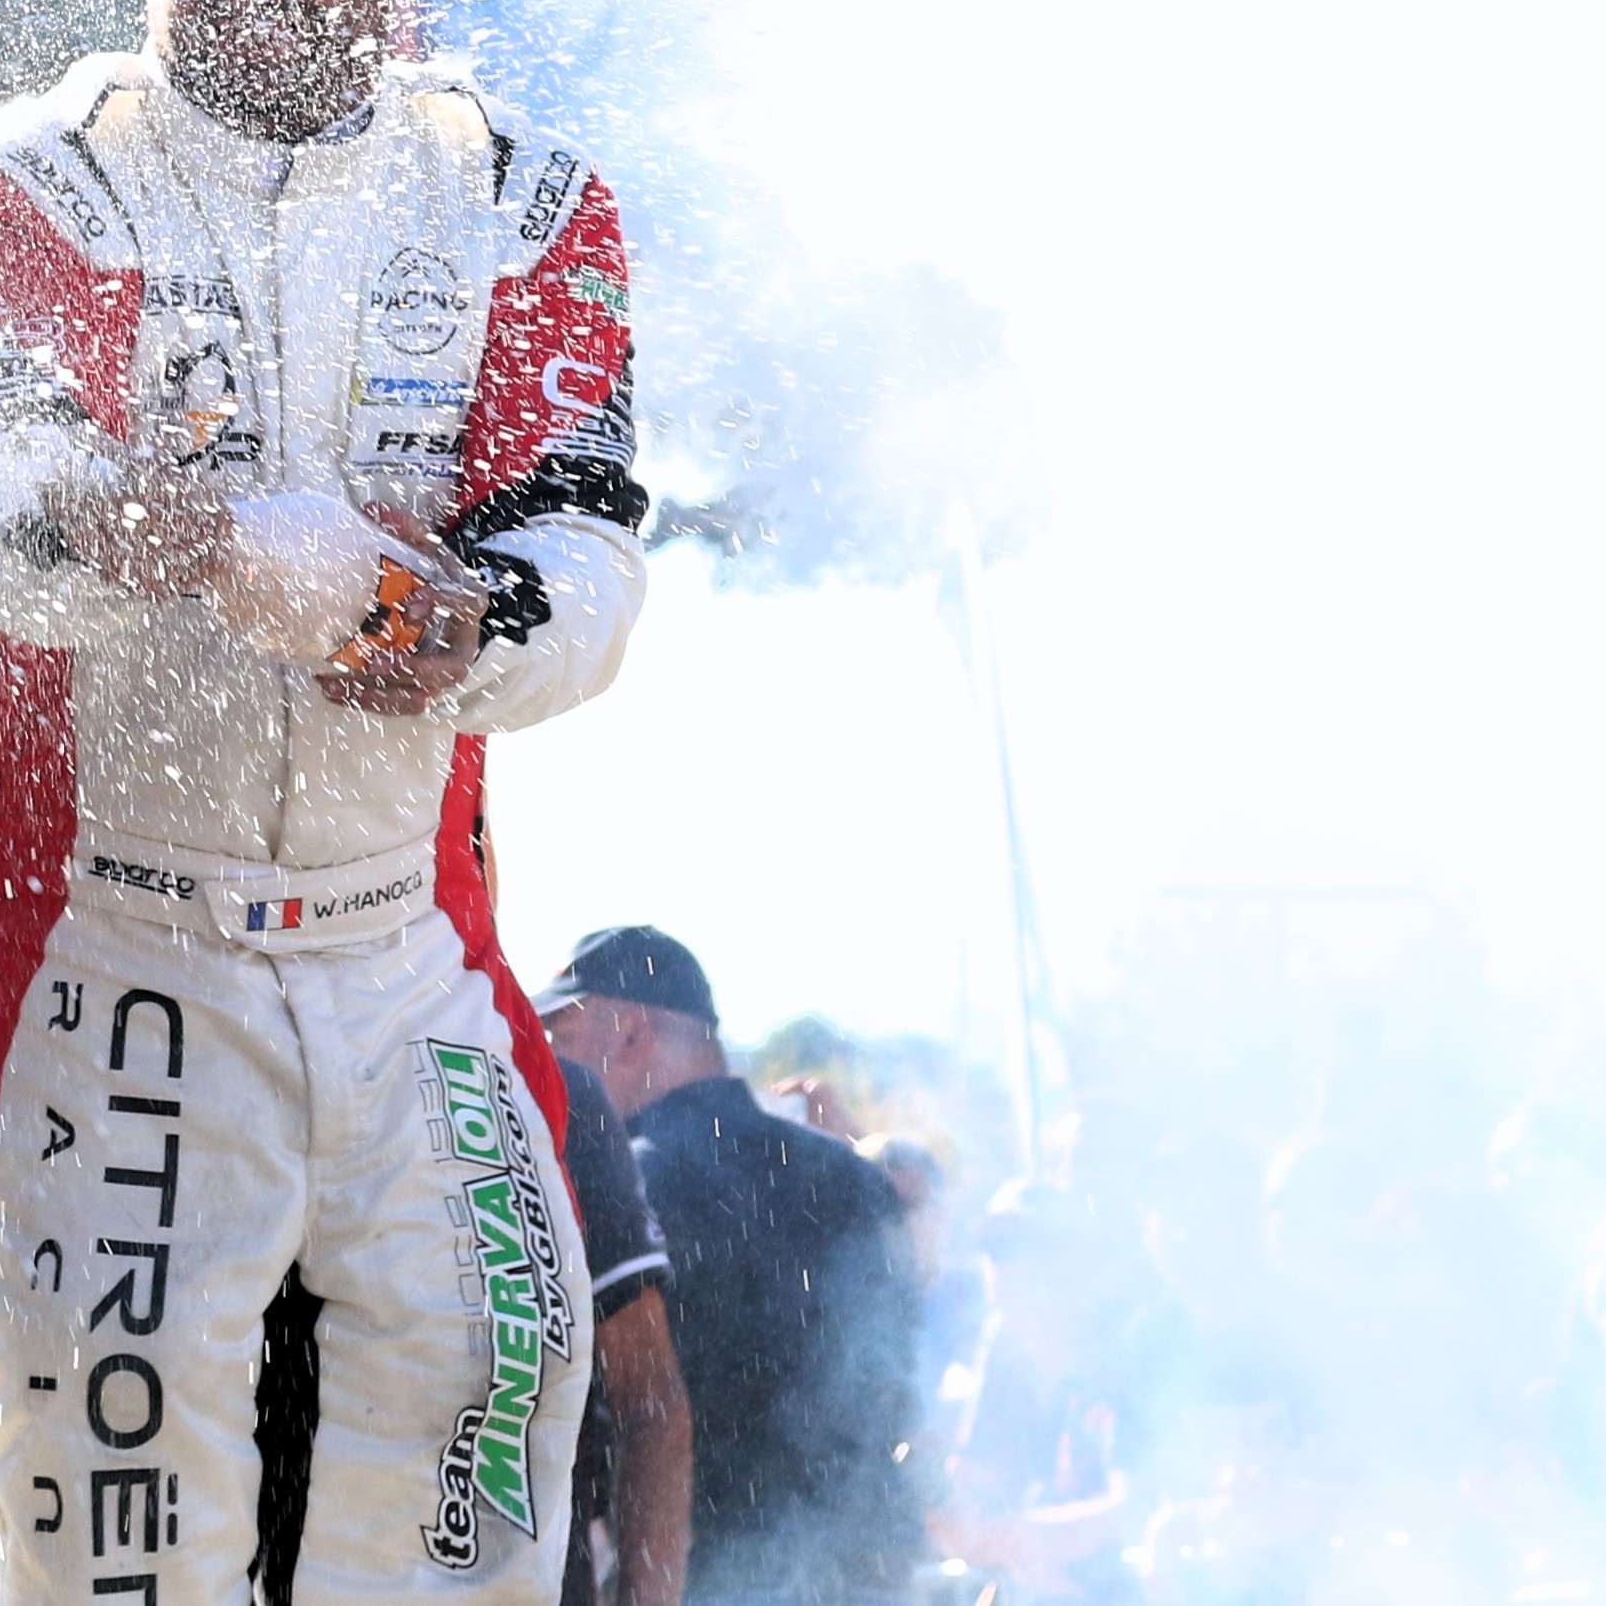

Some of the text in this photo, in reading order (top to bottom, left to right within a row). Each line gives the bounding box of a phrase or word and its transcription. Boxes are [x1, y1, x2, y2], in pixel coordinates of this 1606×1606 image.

[89, 855, 196, 899] sparco
[433, 1046, 540, 1527] MINERVA OIL
[426, 1408, 485, 1566] team
